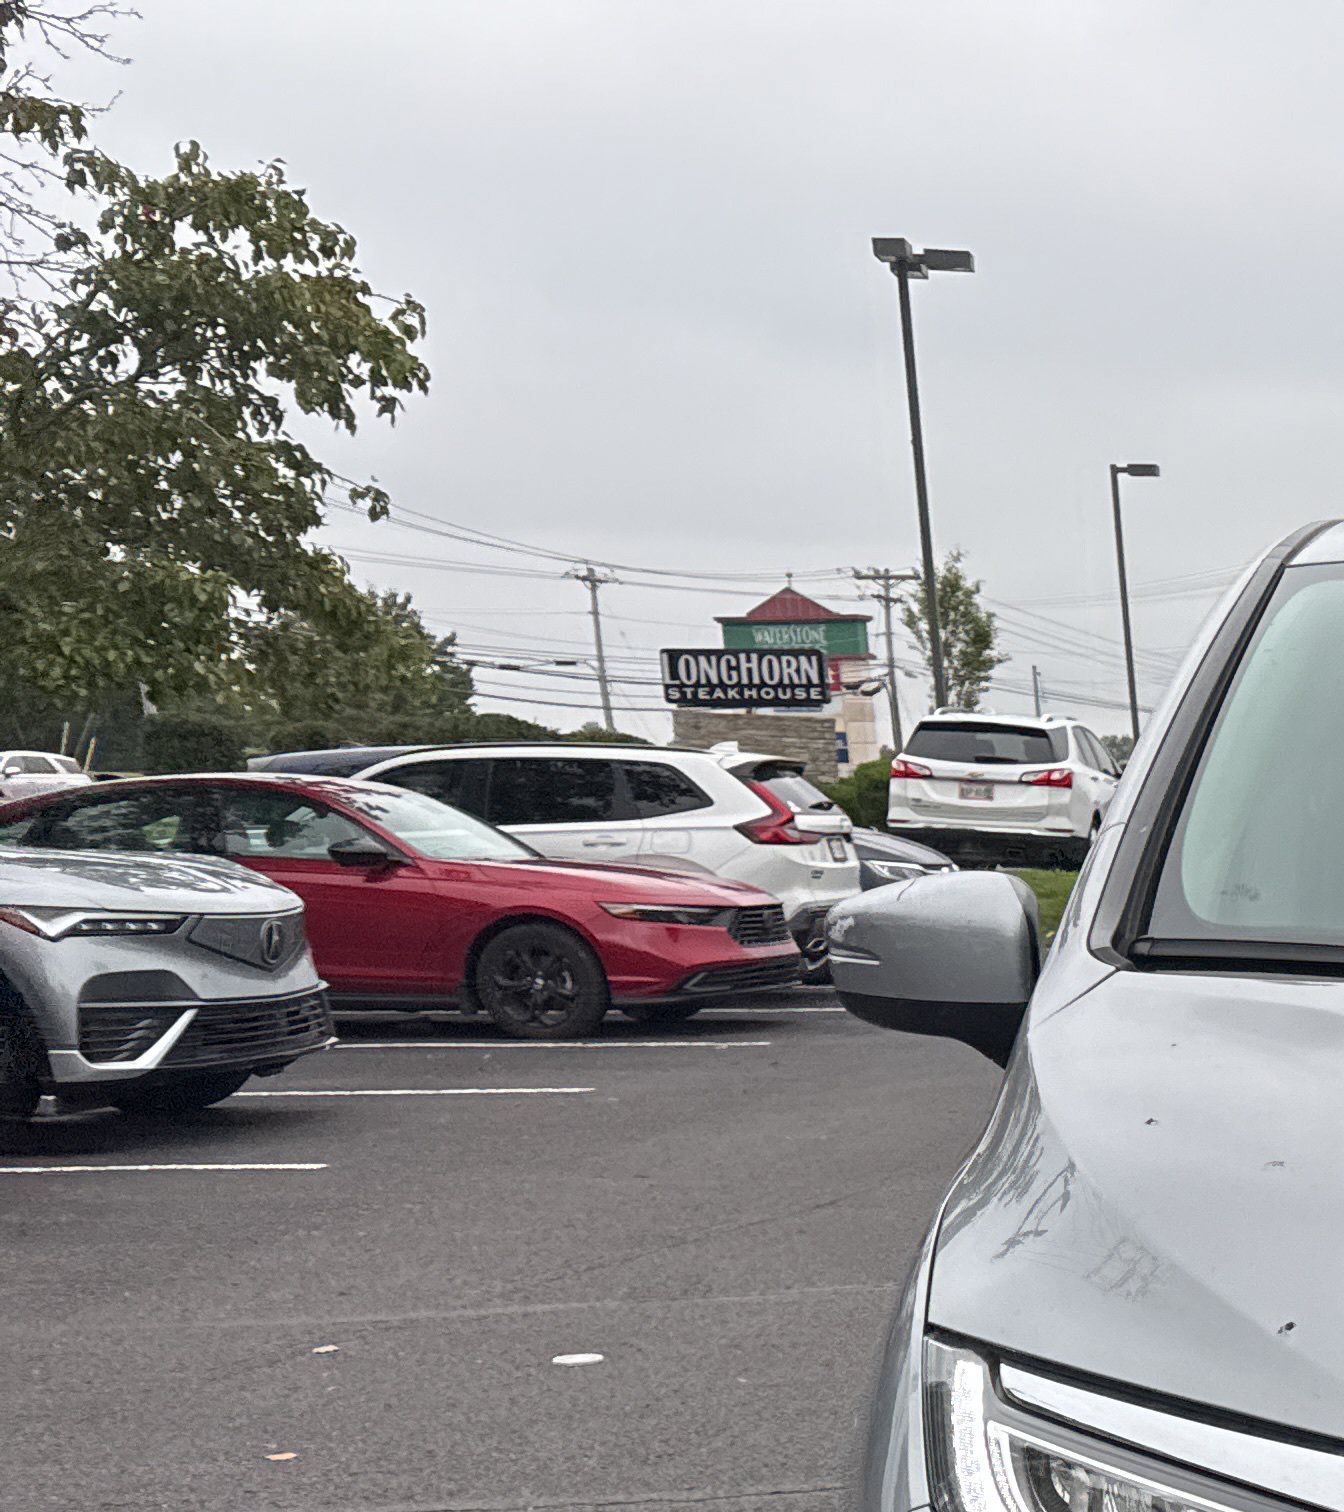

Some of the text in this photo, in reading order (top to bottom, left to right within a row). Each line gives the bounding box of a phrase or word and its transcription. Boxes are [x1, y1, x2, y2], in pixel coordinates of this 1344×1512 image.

[752, 624, 828, 645] WATERSTONE
[661, 653, 821, 685] LONGHORN
[667, 686, 825, 700] STEAKHOUSE
